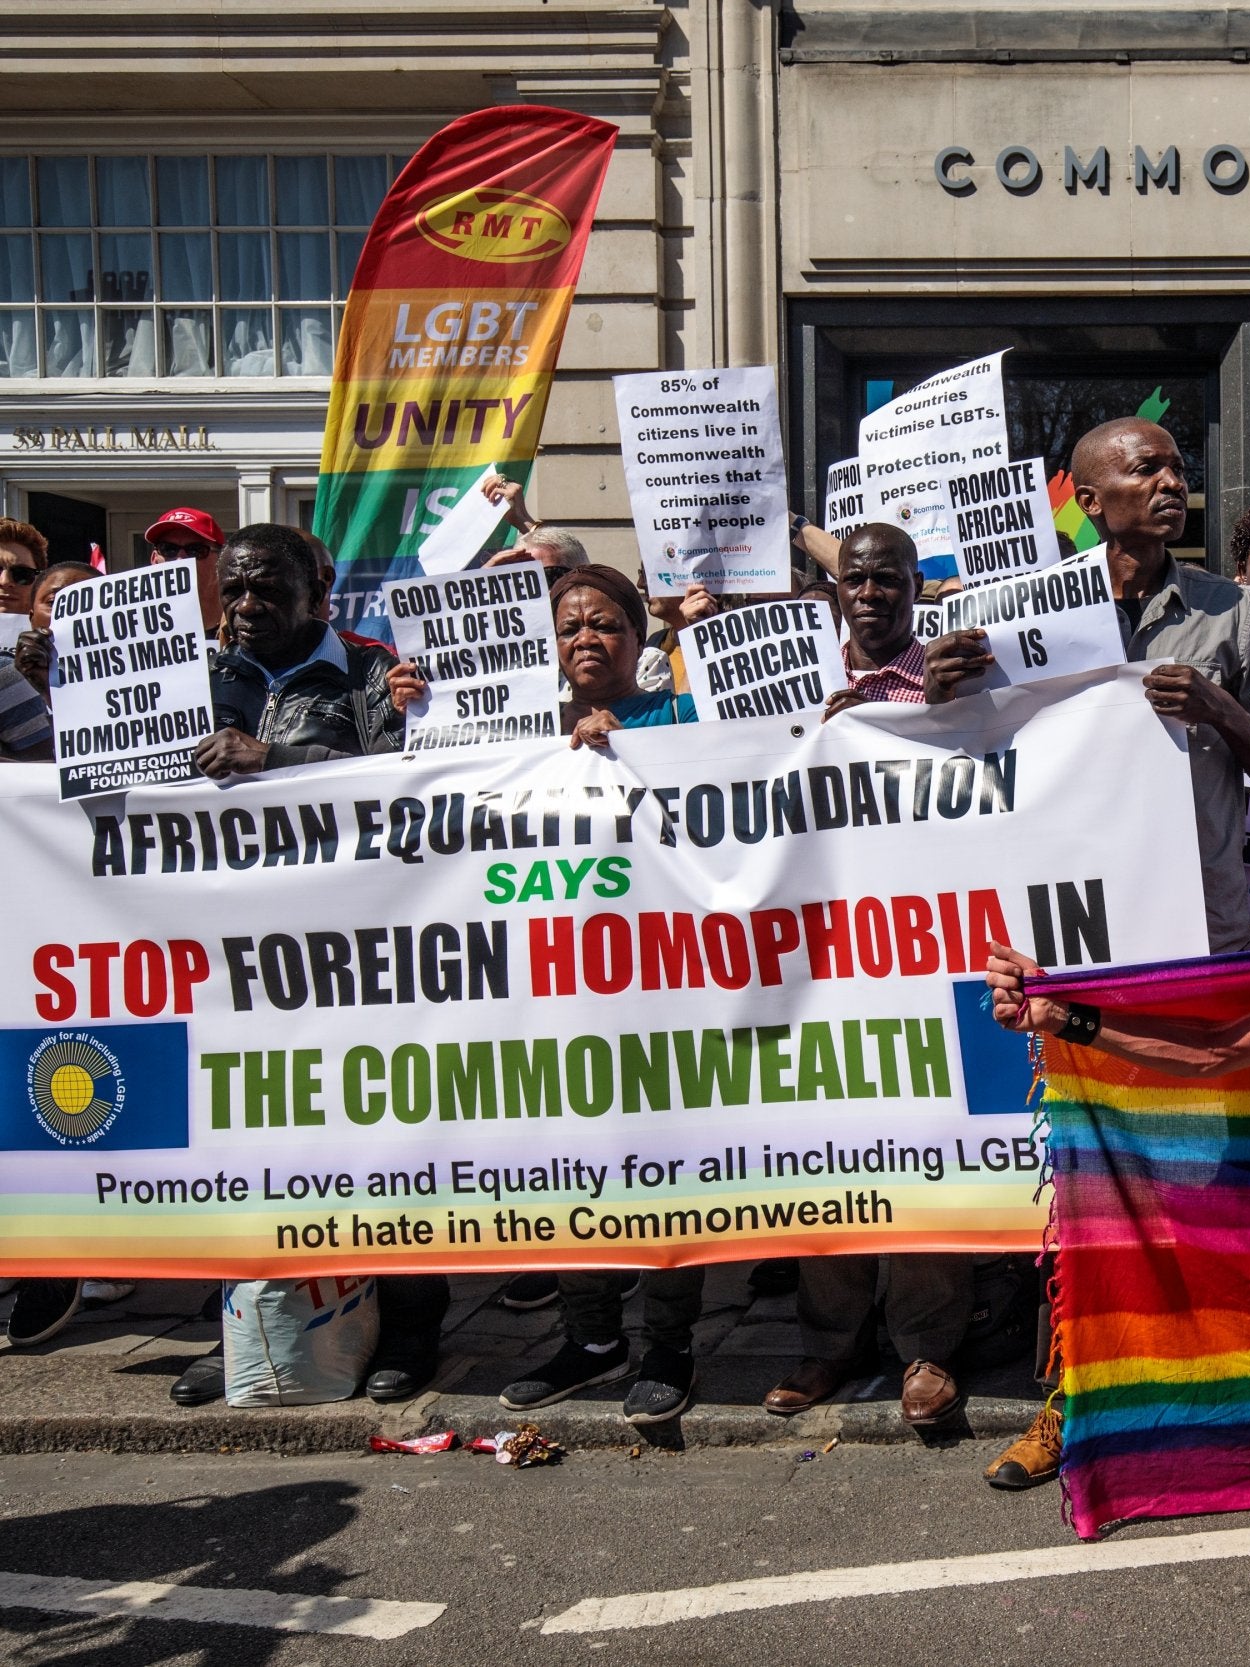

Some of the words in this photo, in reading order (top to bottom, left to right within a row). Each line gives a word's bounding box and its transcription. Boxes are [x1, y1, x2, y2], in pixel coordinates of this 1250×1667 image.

[450, 211, 543, 240] RMT
[393, 301, 538, 344] LGBT
[389, 345, 529, 369] MEMBERS
[660, 378, 697, 393] 85%
[895, 391, 968, 416] countries
[354, 393, 534, 450] UNITY
[630, 399, 760, 419] Commonwealth
[865, 418, 935, 443] victimise
[940, 407, 1000, 427] LGBTs.
[12, 426, 41, 450] 59
[51, 426, 124, 450] PALL
[130, 425, 215, 450] MALL
[637, 427, 700, 441] citizens
[705, 424, 736, 438] live
[637, 446, 765, 465] Commonwealth
[866, 451, 967, 479] Protection,
[972, 441, 1002, 460] not
[645, 471, 720, 487] countries
[725, 469, 762, 482] that
[949, 463, 1036, 509] PROMOTE
[399, 487, 459, 535] IS
[660, 492, 751, 508] criminalise
[653, 518, 702, 531] LGBT+
[708, 514, 766, 531] people
[957, 499, 1035, 543] AFRICAN
[963, 534, 1039, 576] UBUNTU
[54, 586, 93, 620] GOD
[100, 567, 191, 610] CREATED
[391, 584, 442, 618] GOD
[444, 569, 542, 611] CREATED
[946, 561, 1110, 629] HOMOPHOBIA
[73, 615, 109, 648] ALL
[112, 608, 138, 641] OF
[143, 603, 174, 634] US
[423, 616, 459, 649] ALL
[462, 611, 489, 643] OF
[494, 607, 526, 638] US
[693, 602, 823, 659] PROMOTE
[89, 646, 126, 680] HIS
[128, 632, 199, 672] IMAGE
[437, 648, 476, 680] HIS
[480, 638, 550, 675] IMAGE
[706, 638, 819, 696] AFRICAN
[1018, 629, 1048, 669] IS
[105, 681, 161, 718] STOP
[456, 684, 510, 719] STOP
[59, 706, 211, 758] HOMOPHOBIA
[68, 759, 135, 781] AFRICAN
[90, 764, 191, 790] FOUNDATION
[92, 801, 338, 877] AFRICAN
[354, 786, 648, 866] EQUALITY
[650, 748, 1018, 849] FOUNDATION
[484, 856, 632, 904] SAYS
[33, 940, 210, 1022] STOP
[223, 920, 509, 1012] FOREIGN
[528, 888, 1012, 998] HOMOPHOBIA
[1026, 878, 1112, 968] IN
[29, 1034, 57, 1064] Equality
[59, 1031, 74, 1041] for
[76, 1032, 88, 1041] all
[89, 1036, 122, 1077] including
[200, 1048, 327, 1130] THE
[342, 1018, 952, 1126] COMMONWEALTH
[113, 1078, 126, 1113] LGBTI
[36, 1113, 66, 1145] Promote
[97, 1171, 248, 1205] Promote
[263, 1166, 355, 1200] Love
[367, 1163, 437, 1195] and
[451, 1157, 608, 1199] Equality
[621, 1152, 684, 1189] for
[698, 1146, 747, 1181] all
[762, 1138, 943, 1181] including
[276, 1216, 339, 1249] not
[351, 1211, 434, 1245] hate
[447, 1209, 481, 1243] in
[493, 1206, 554, 1241] the
[568, 1190, 894, 1242] Commonwealth
